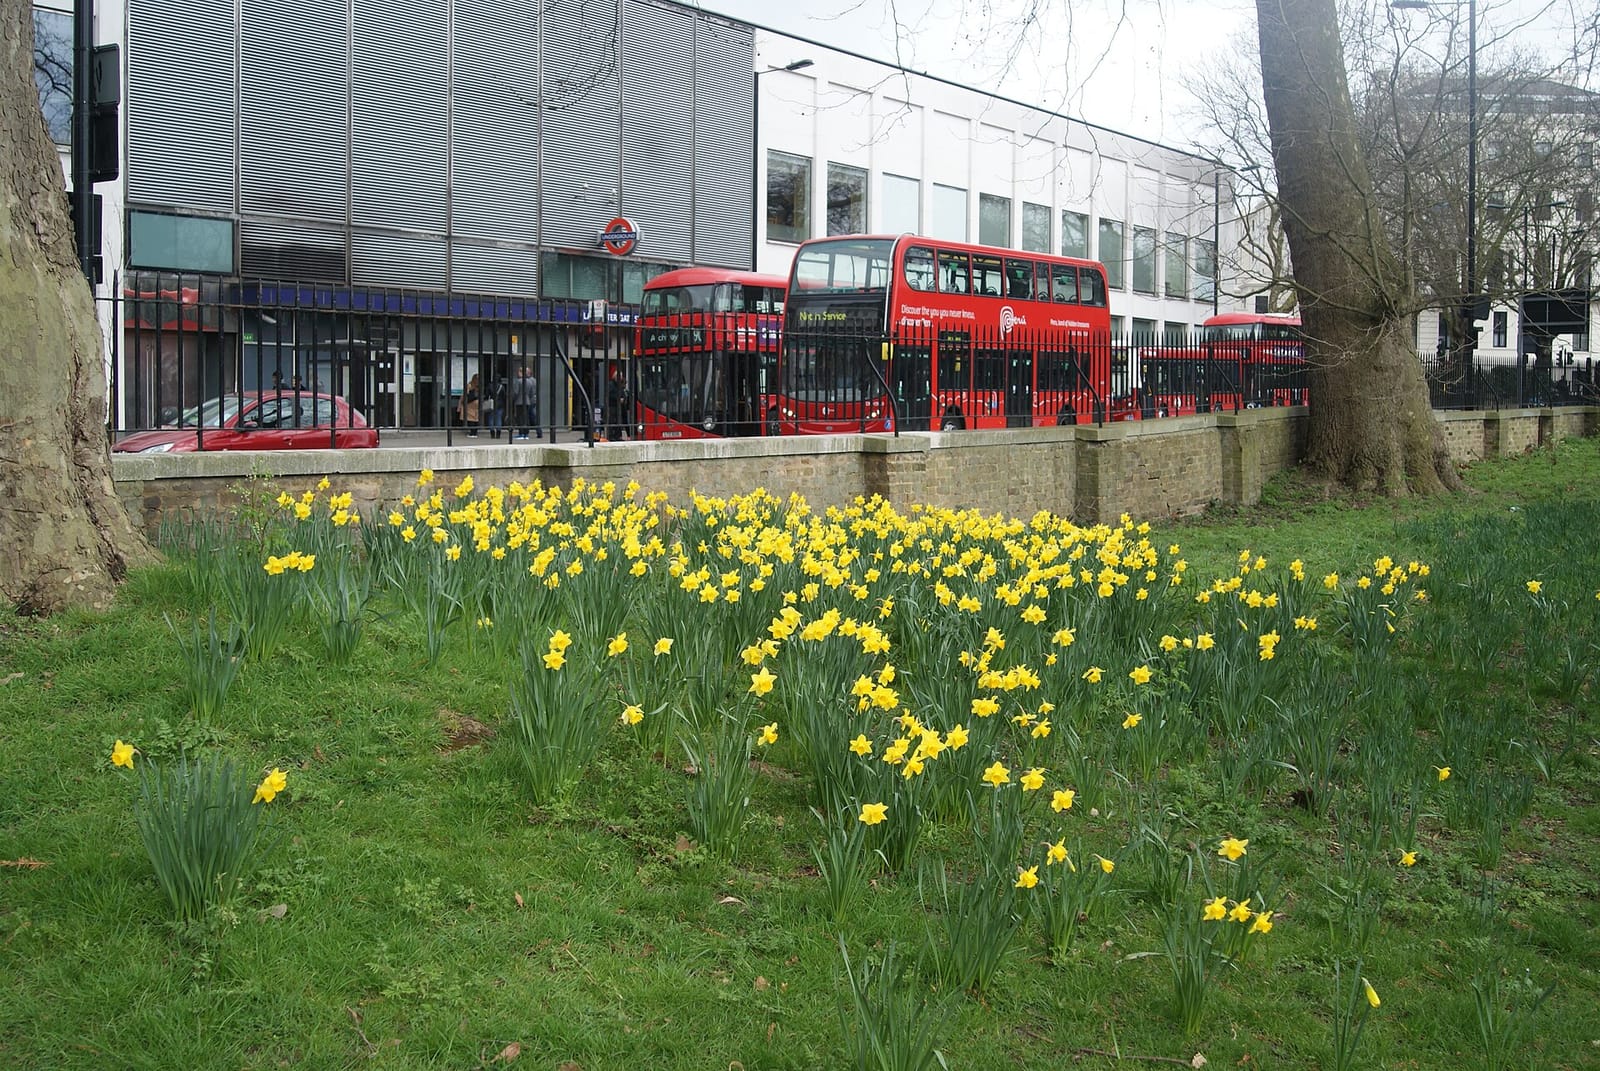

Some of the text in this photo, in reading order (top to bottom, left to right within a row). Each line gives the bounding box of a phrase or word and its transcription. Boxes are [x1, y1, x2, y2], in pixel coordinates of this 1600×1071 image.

[901, 304, 921, 315] Discover
[921, 306, 929, 316] the
[930, 308, 939, 319] you
[940, 309, 949, 319] you
[949, 310, 962, 318] never
